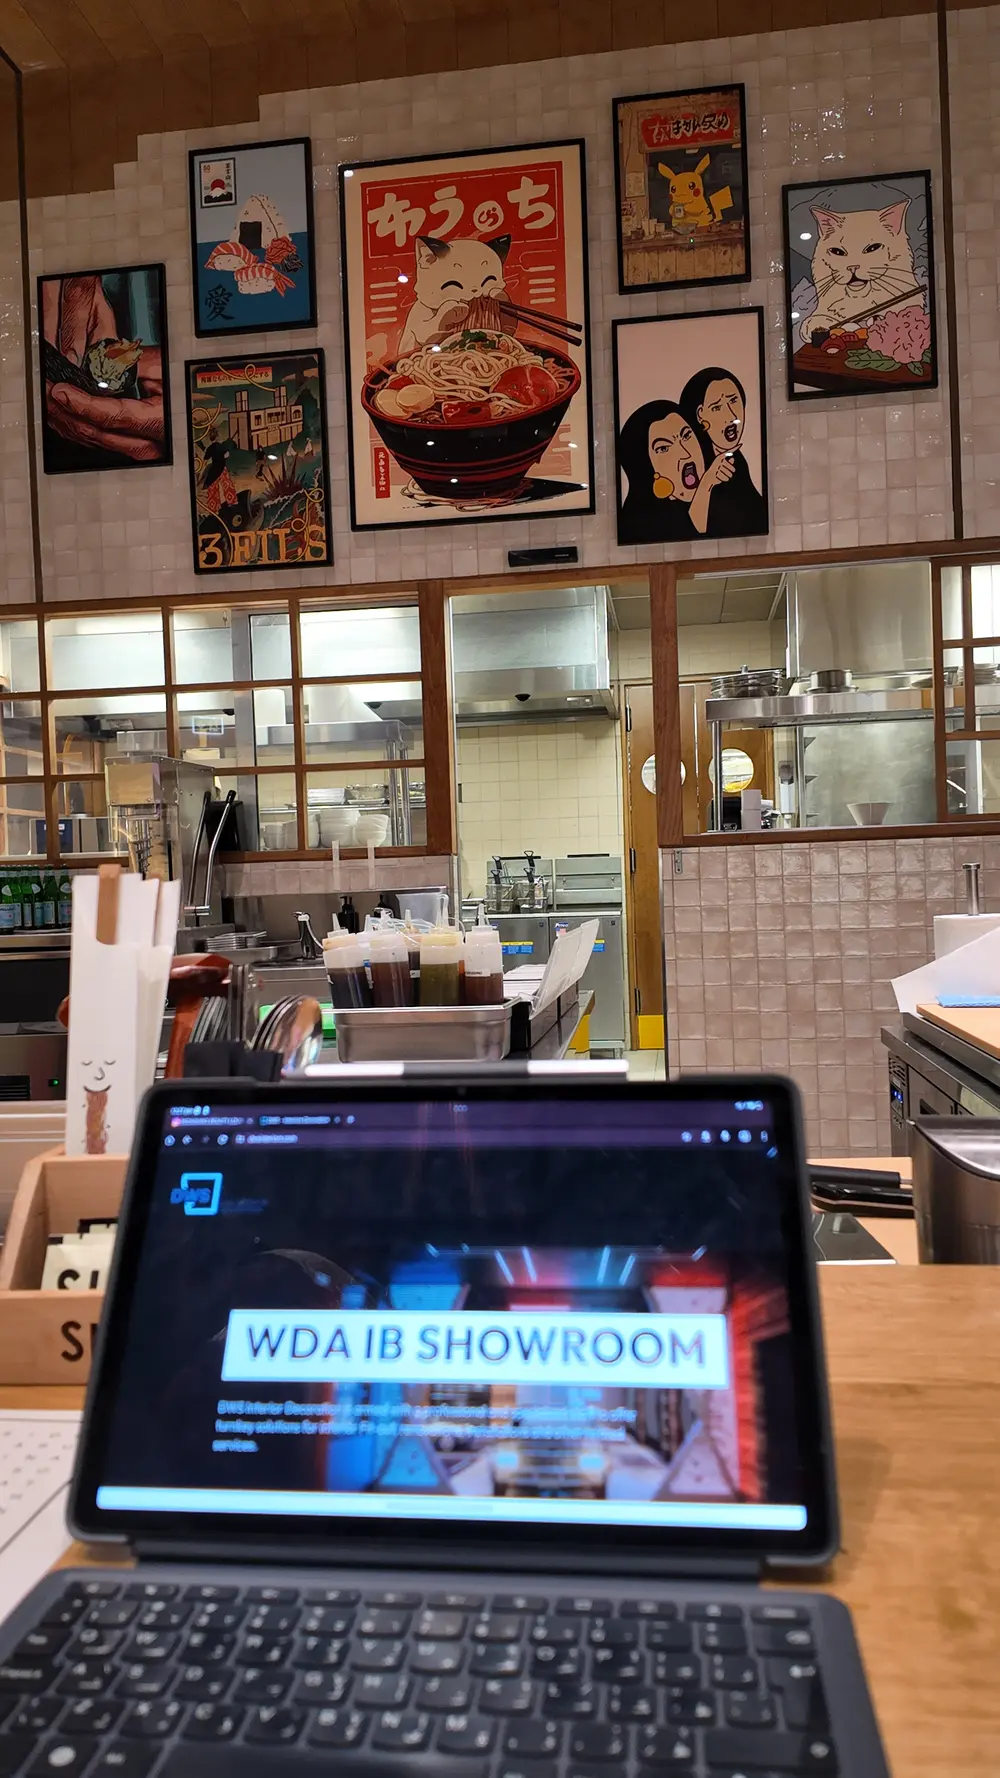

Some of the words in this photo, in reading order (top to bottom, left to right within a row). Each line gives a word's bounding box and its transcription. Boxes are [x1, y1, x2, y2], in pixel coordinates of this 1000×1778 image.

[198, 532, 223, 569] 3
[169, 1188, 212, 1205] DWS
[247, 1327, 350, 1359] WDA
[365, 1327, 403, 1360] IB
[417, 1328, 705, 1365] SHOWROOM
